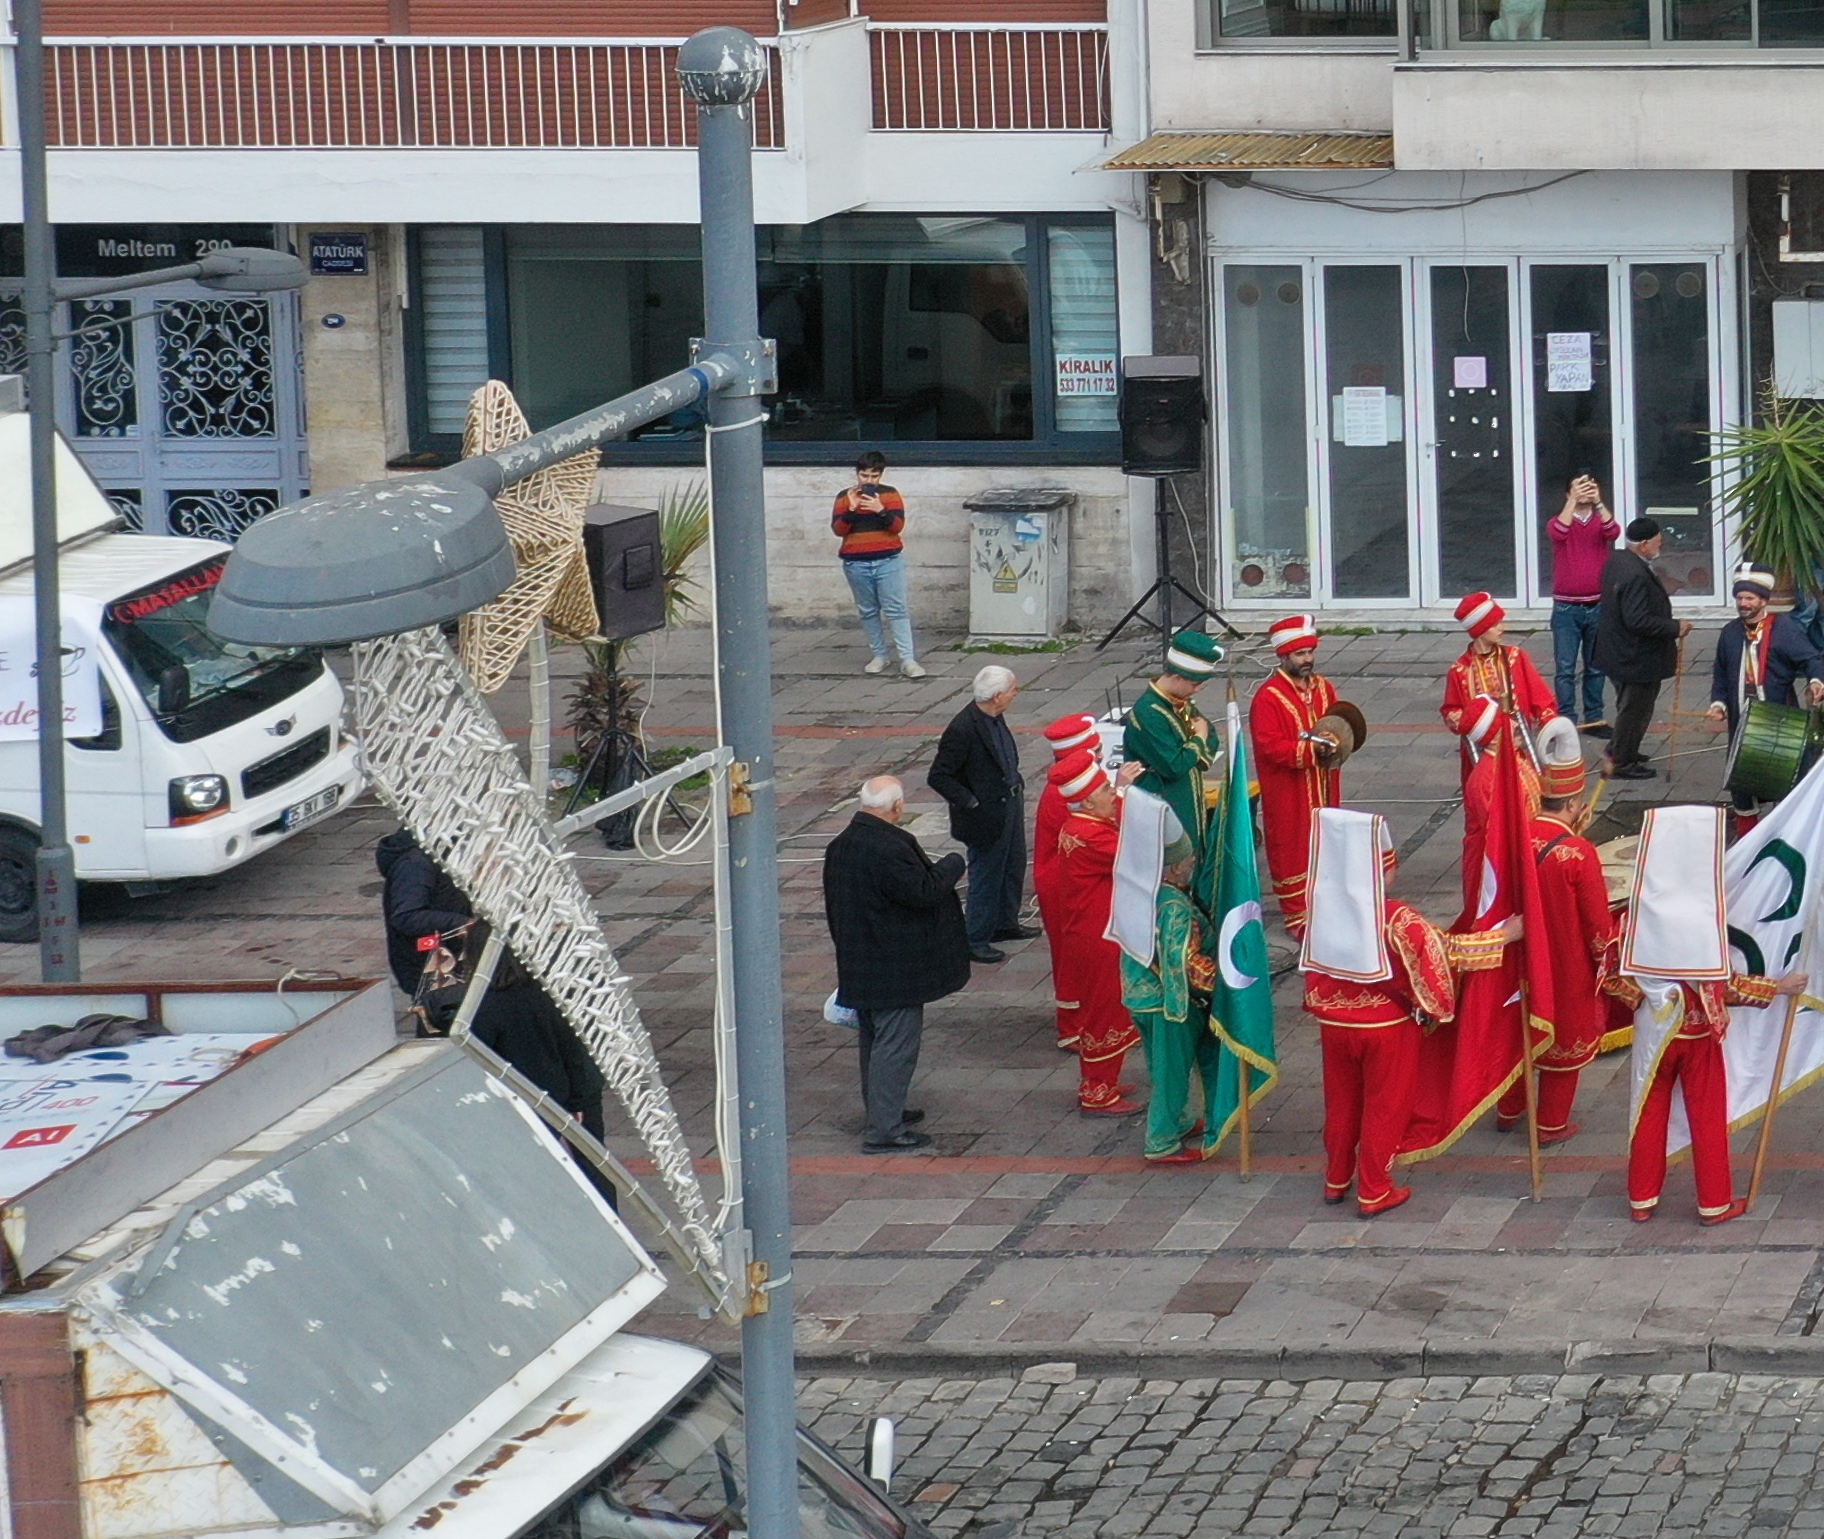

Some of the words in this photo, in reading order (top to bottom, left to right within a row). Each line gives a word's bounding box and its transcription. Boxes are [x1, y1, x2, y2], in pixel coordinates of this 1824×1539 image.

[98, 238, 177, 258] Meltem
[312, 243, 364, 258] ATATÜRK
[1059, 356, 1114, 374] KİRALIK
[39, 1095, 100, 1110] 400
